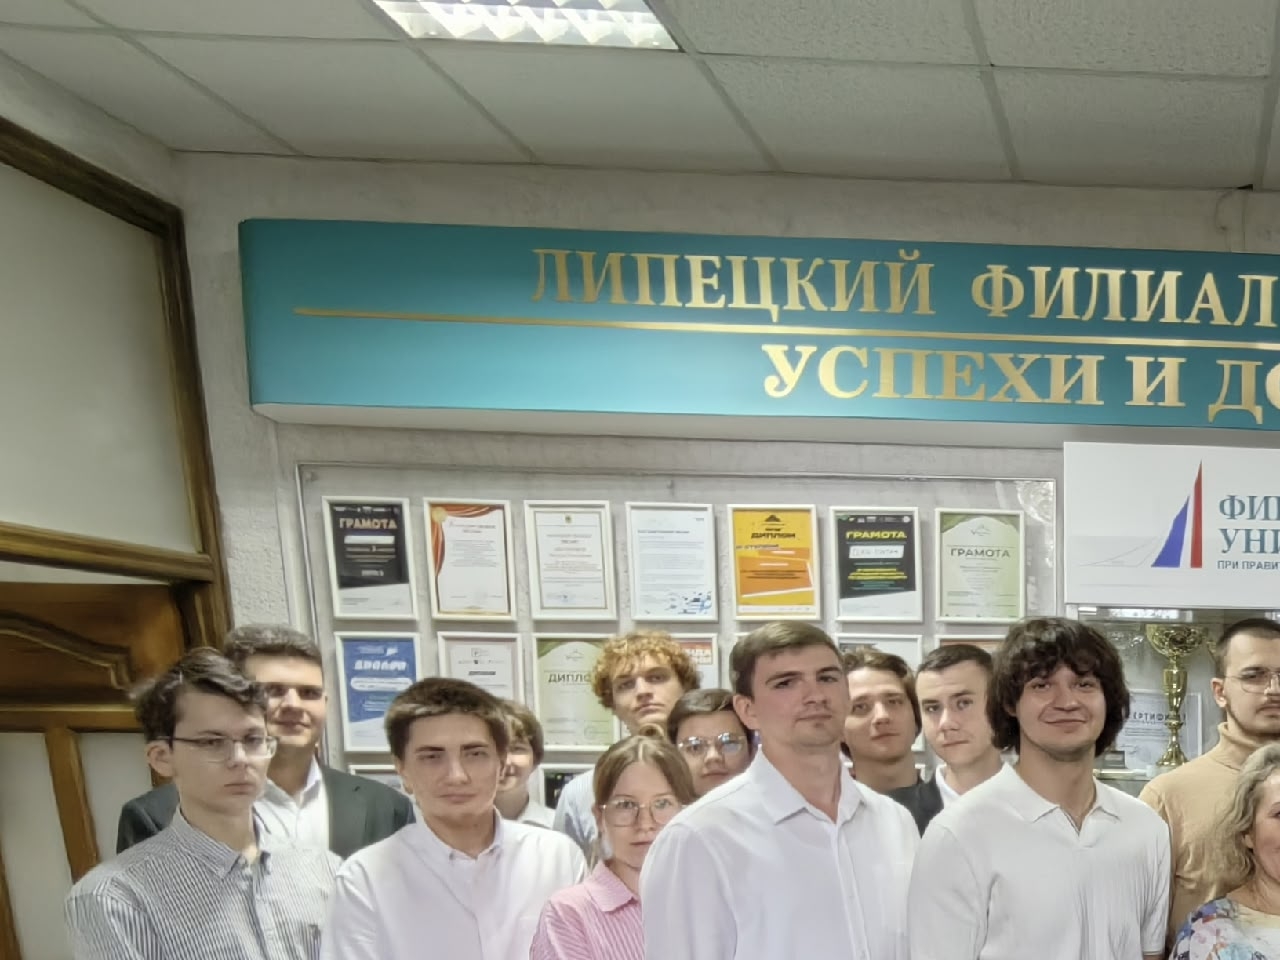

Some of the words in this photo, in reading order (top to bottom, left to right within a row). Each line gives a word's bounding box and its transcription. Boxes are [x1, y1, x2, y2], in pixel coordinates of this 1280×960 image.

[531, 248, 936, 322] ЛИПЕЦКИЙ
[971, 264, 1279, 328] ФИЛИАЛ
[761, 344, 1105, 406] УСПЕХИ
[1125, 356, 1187, 407] И
[339, 517, 398, 529] ГРАМОТА
[845, 530, 908, 540] ГРАМОТА
[950, 547, 1011, 558] ГРАМОТА
[1217, 560, 1239, 570] ПРИ
[548, 673, 593, 683] ДИПЛО
